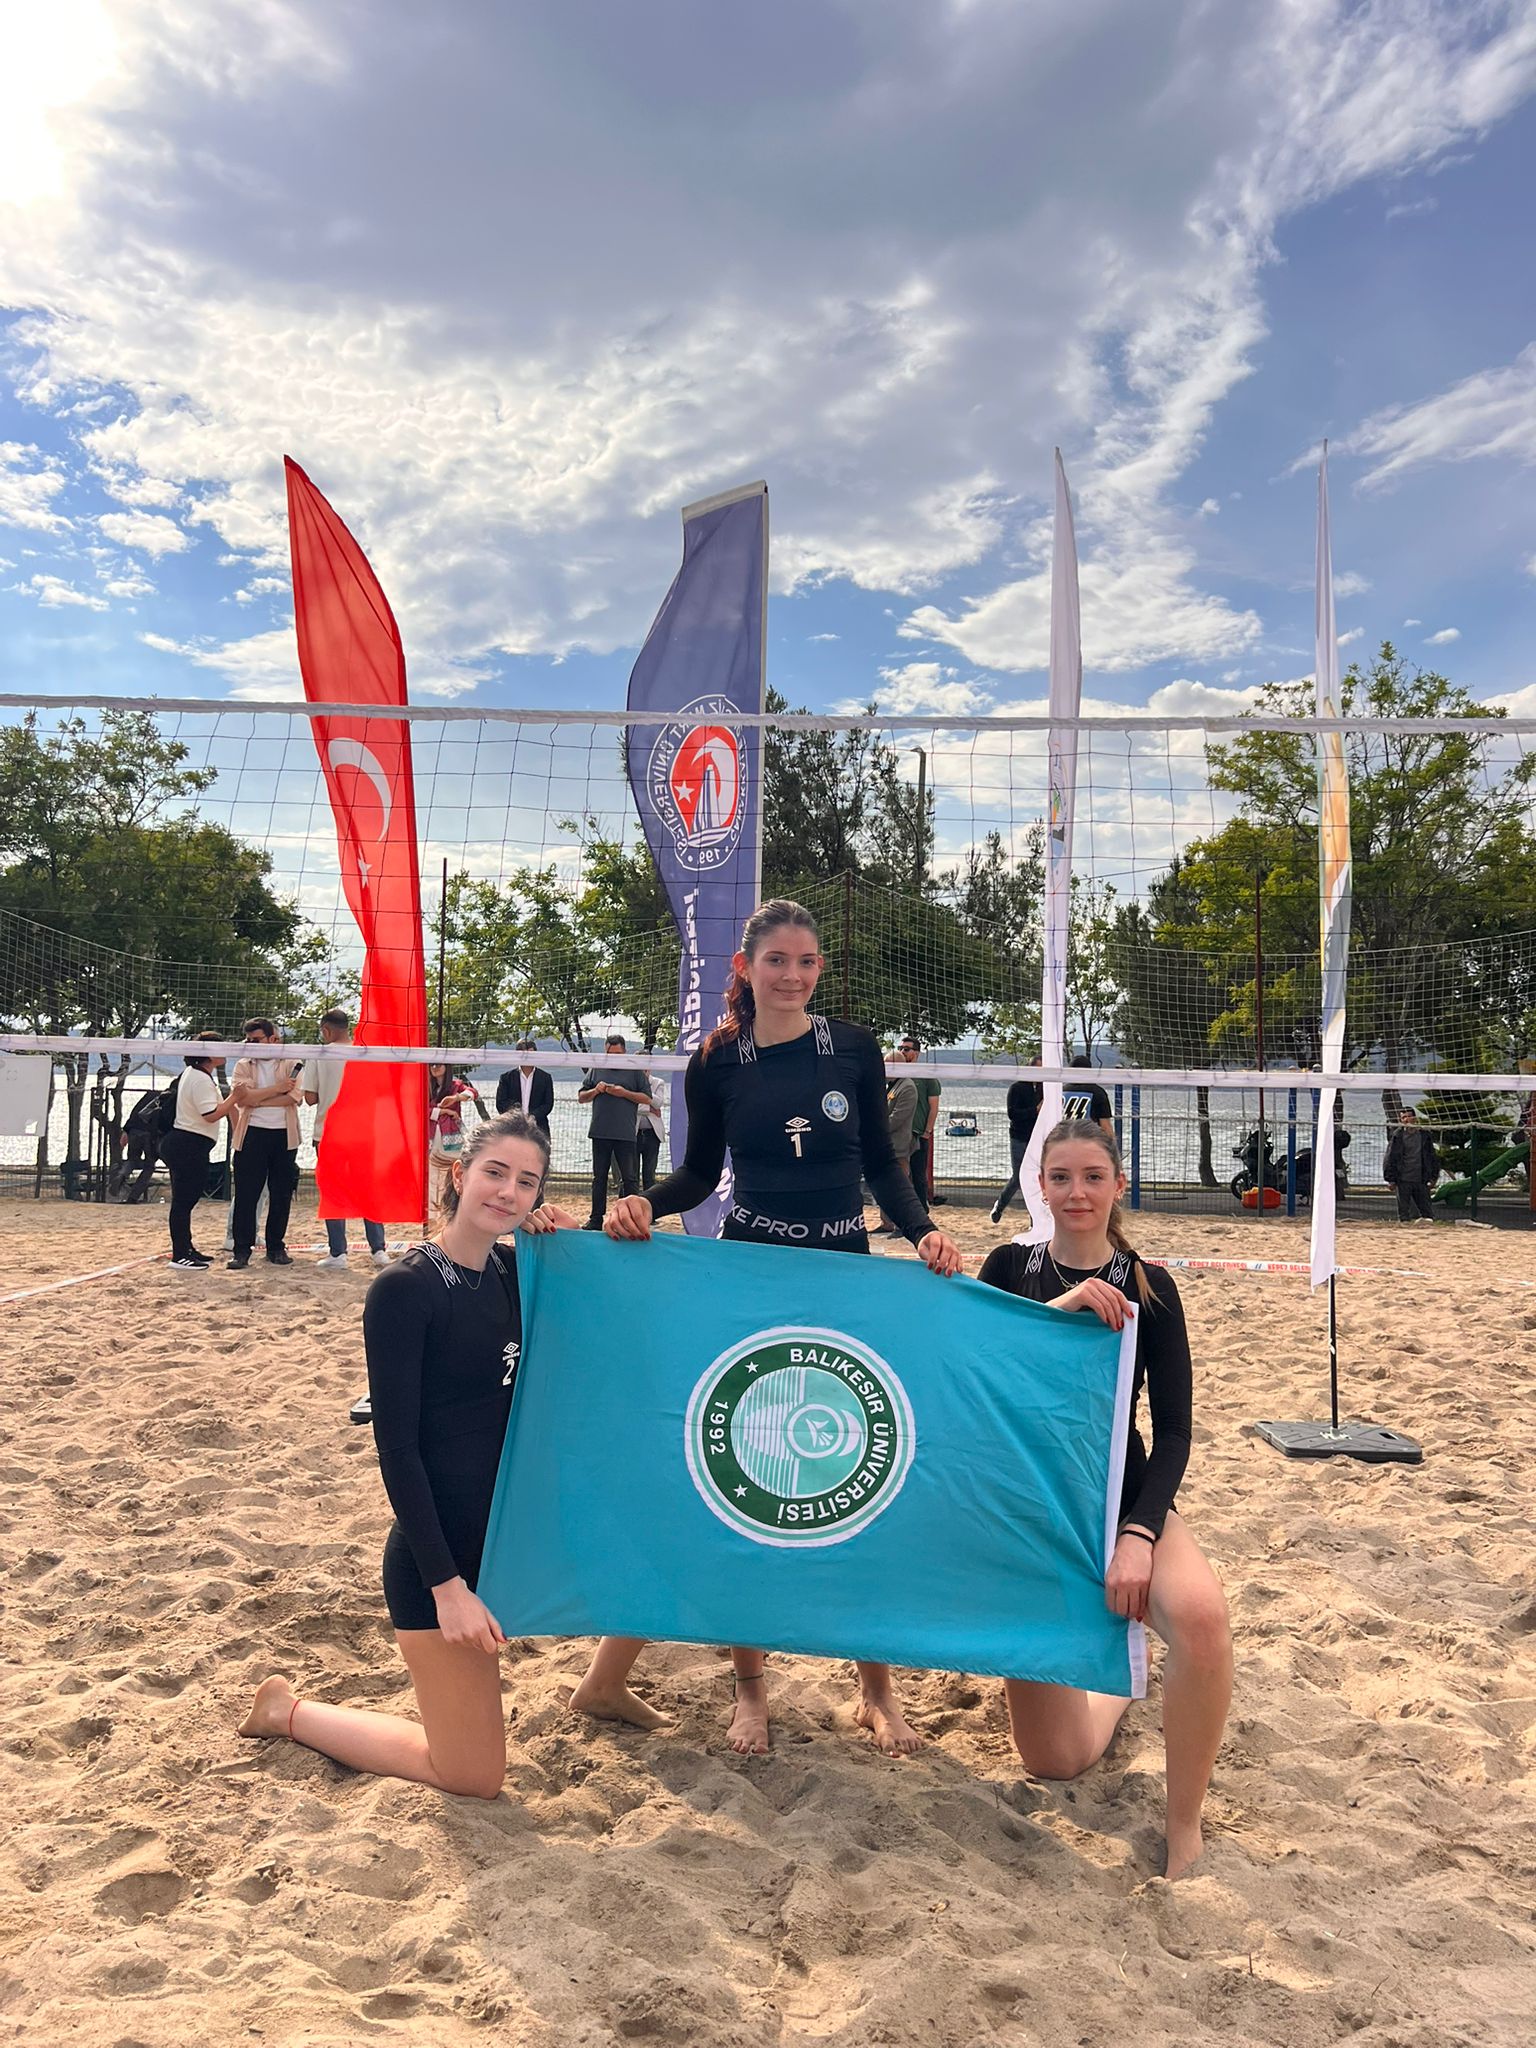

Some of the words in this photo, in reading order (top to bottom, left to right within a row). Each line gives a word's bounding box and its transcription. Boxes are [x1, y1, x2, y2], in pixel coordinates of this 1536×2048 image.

[791, 1133, 803, 1158] 1
[751, 1217, 809, 1239] PRO
[821, 1214, 866, 1238] NIKE
[502, 1358, 515, 1386] 2
[790, 1348, 885, 1415] BALIKESİR
[709, 1401, 730, 1455] 1992
[777, 1421, 894, 1525] ÜNİVERSİTESİ
